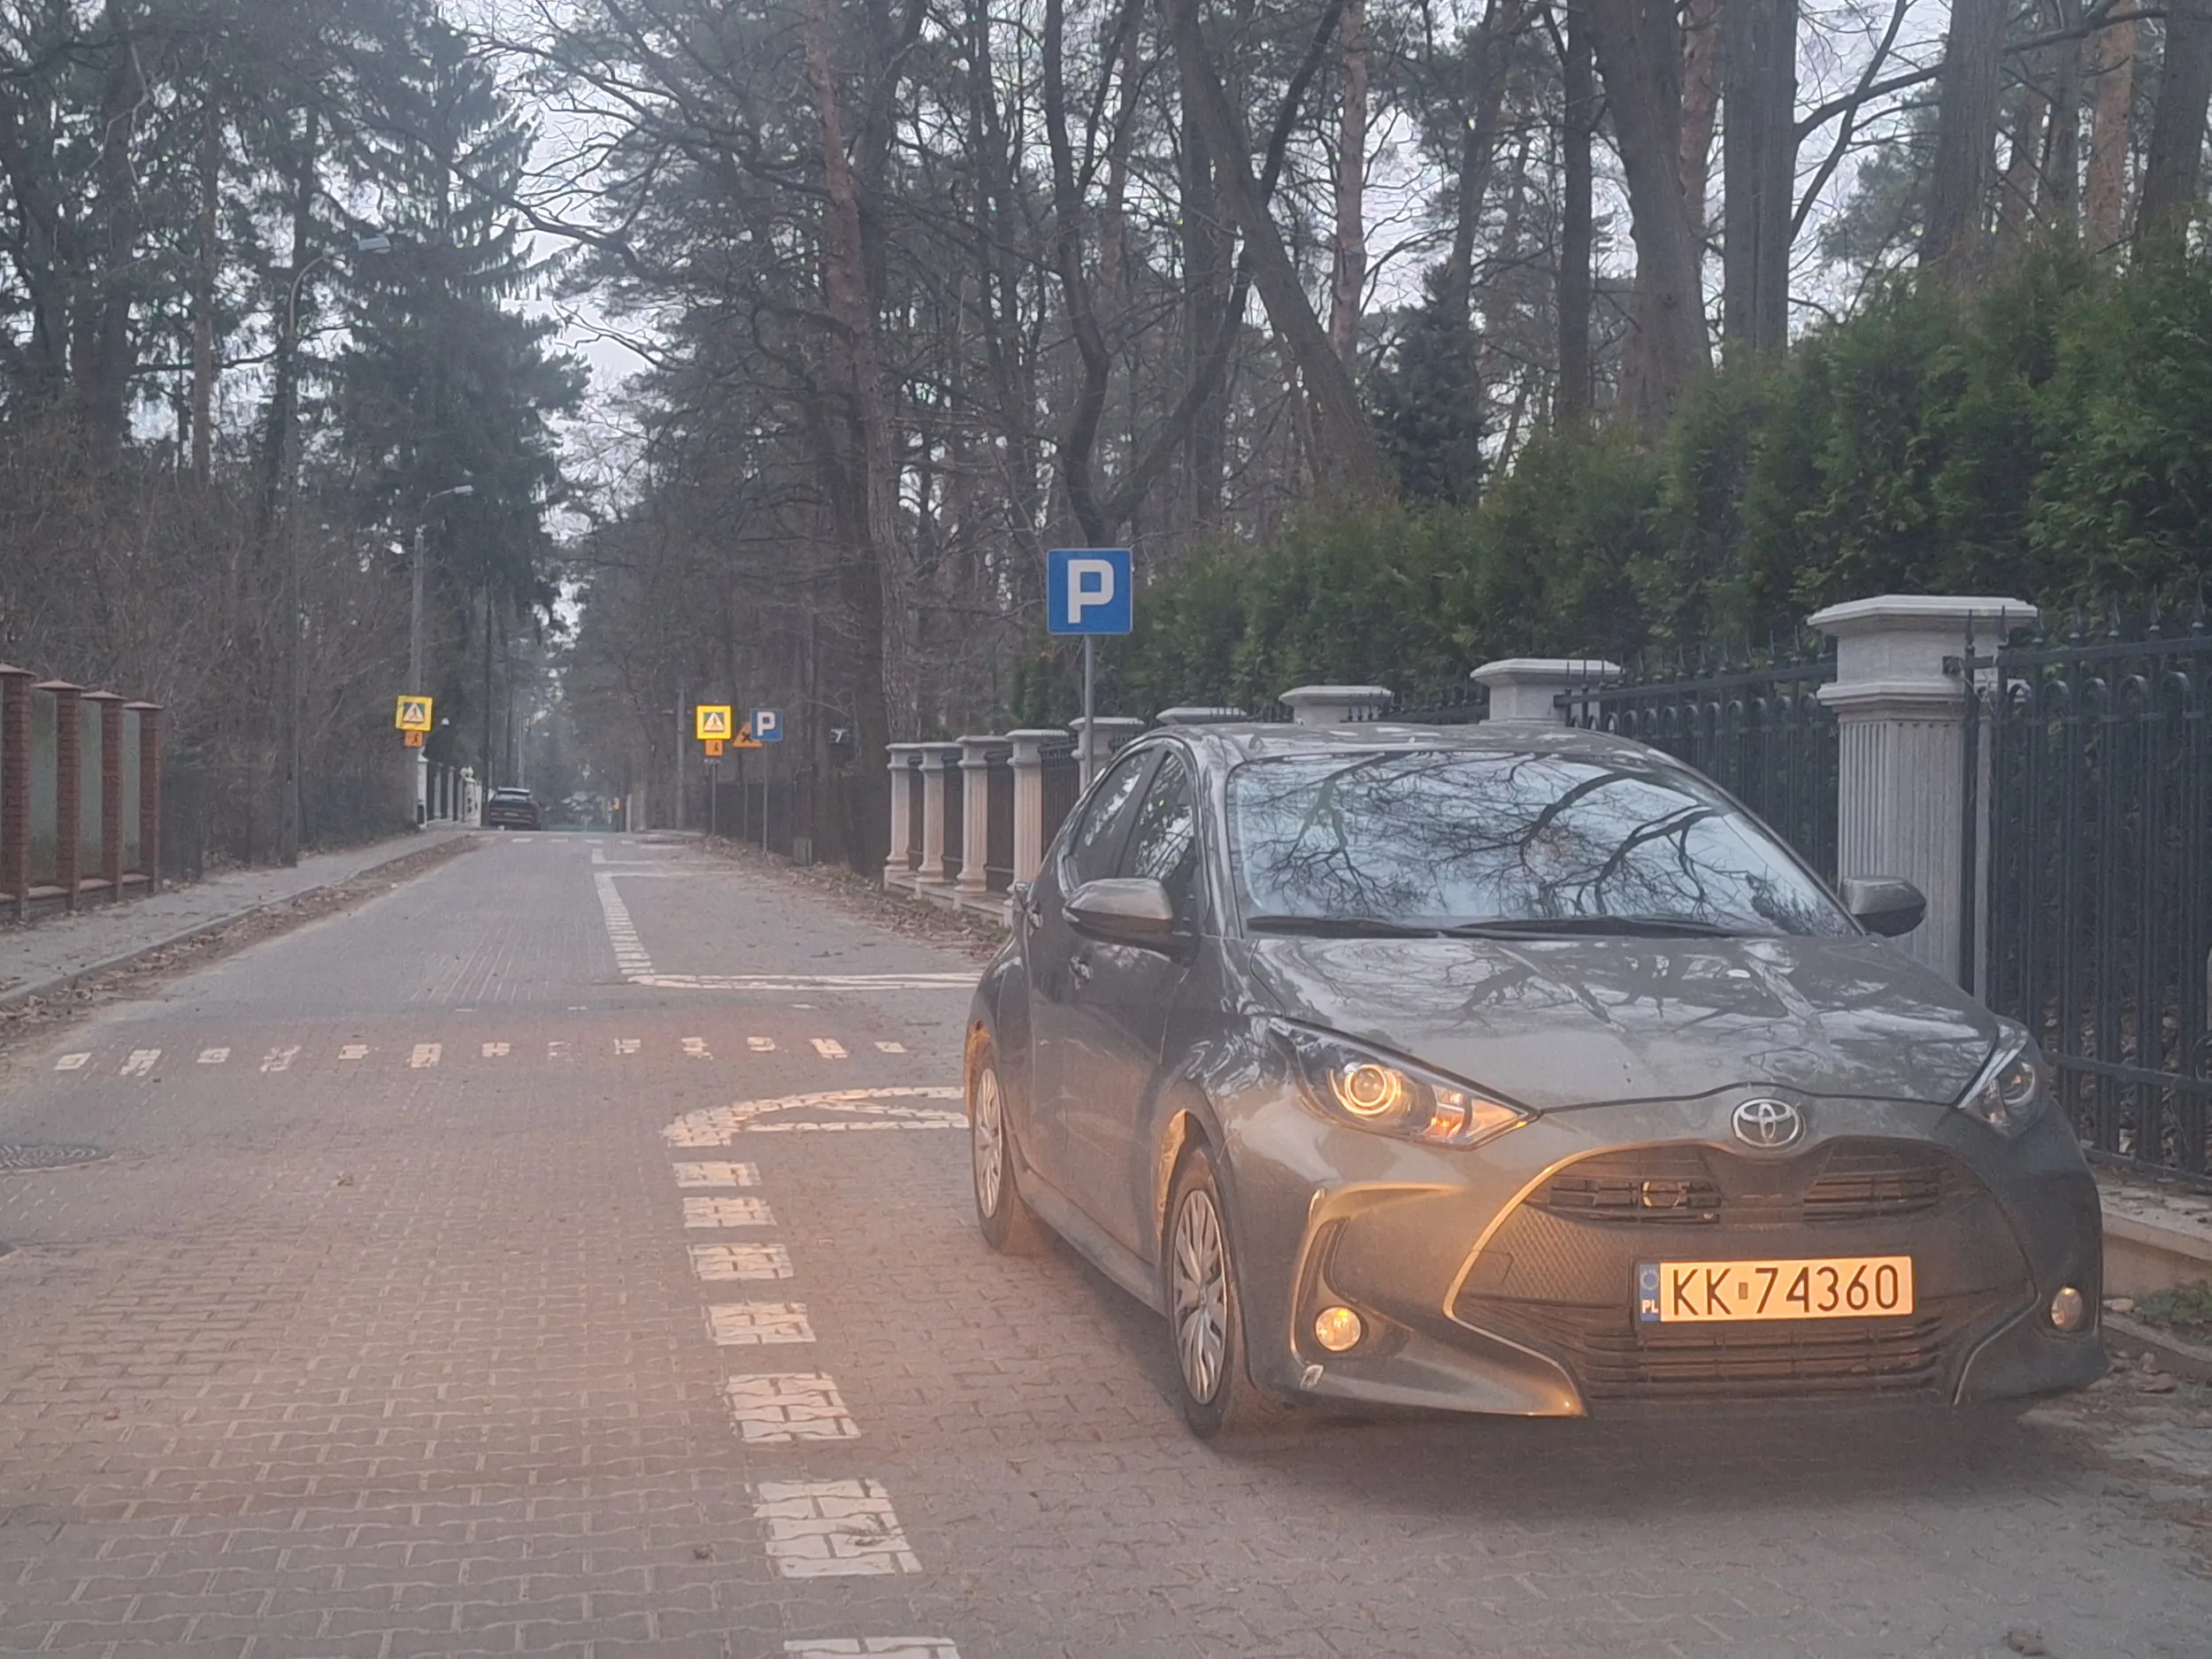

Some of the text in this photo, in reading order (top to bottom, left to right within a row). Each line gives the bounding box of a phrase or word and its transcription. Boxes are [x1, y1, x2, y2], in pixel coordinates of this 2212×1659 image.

[1067, 559, 1114, 624] P
[757, 711, 776, 737] P
[1641, 1299, 1659, 1314] PL
[1672, 1263, 1899, 1316] KK 74360
